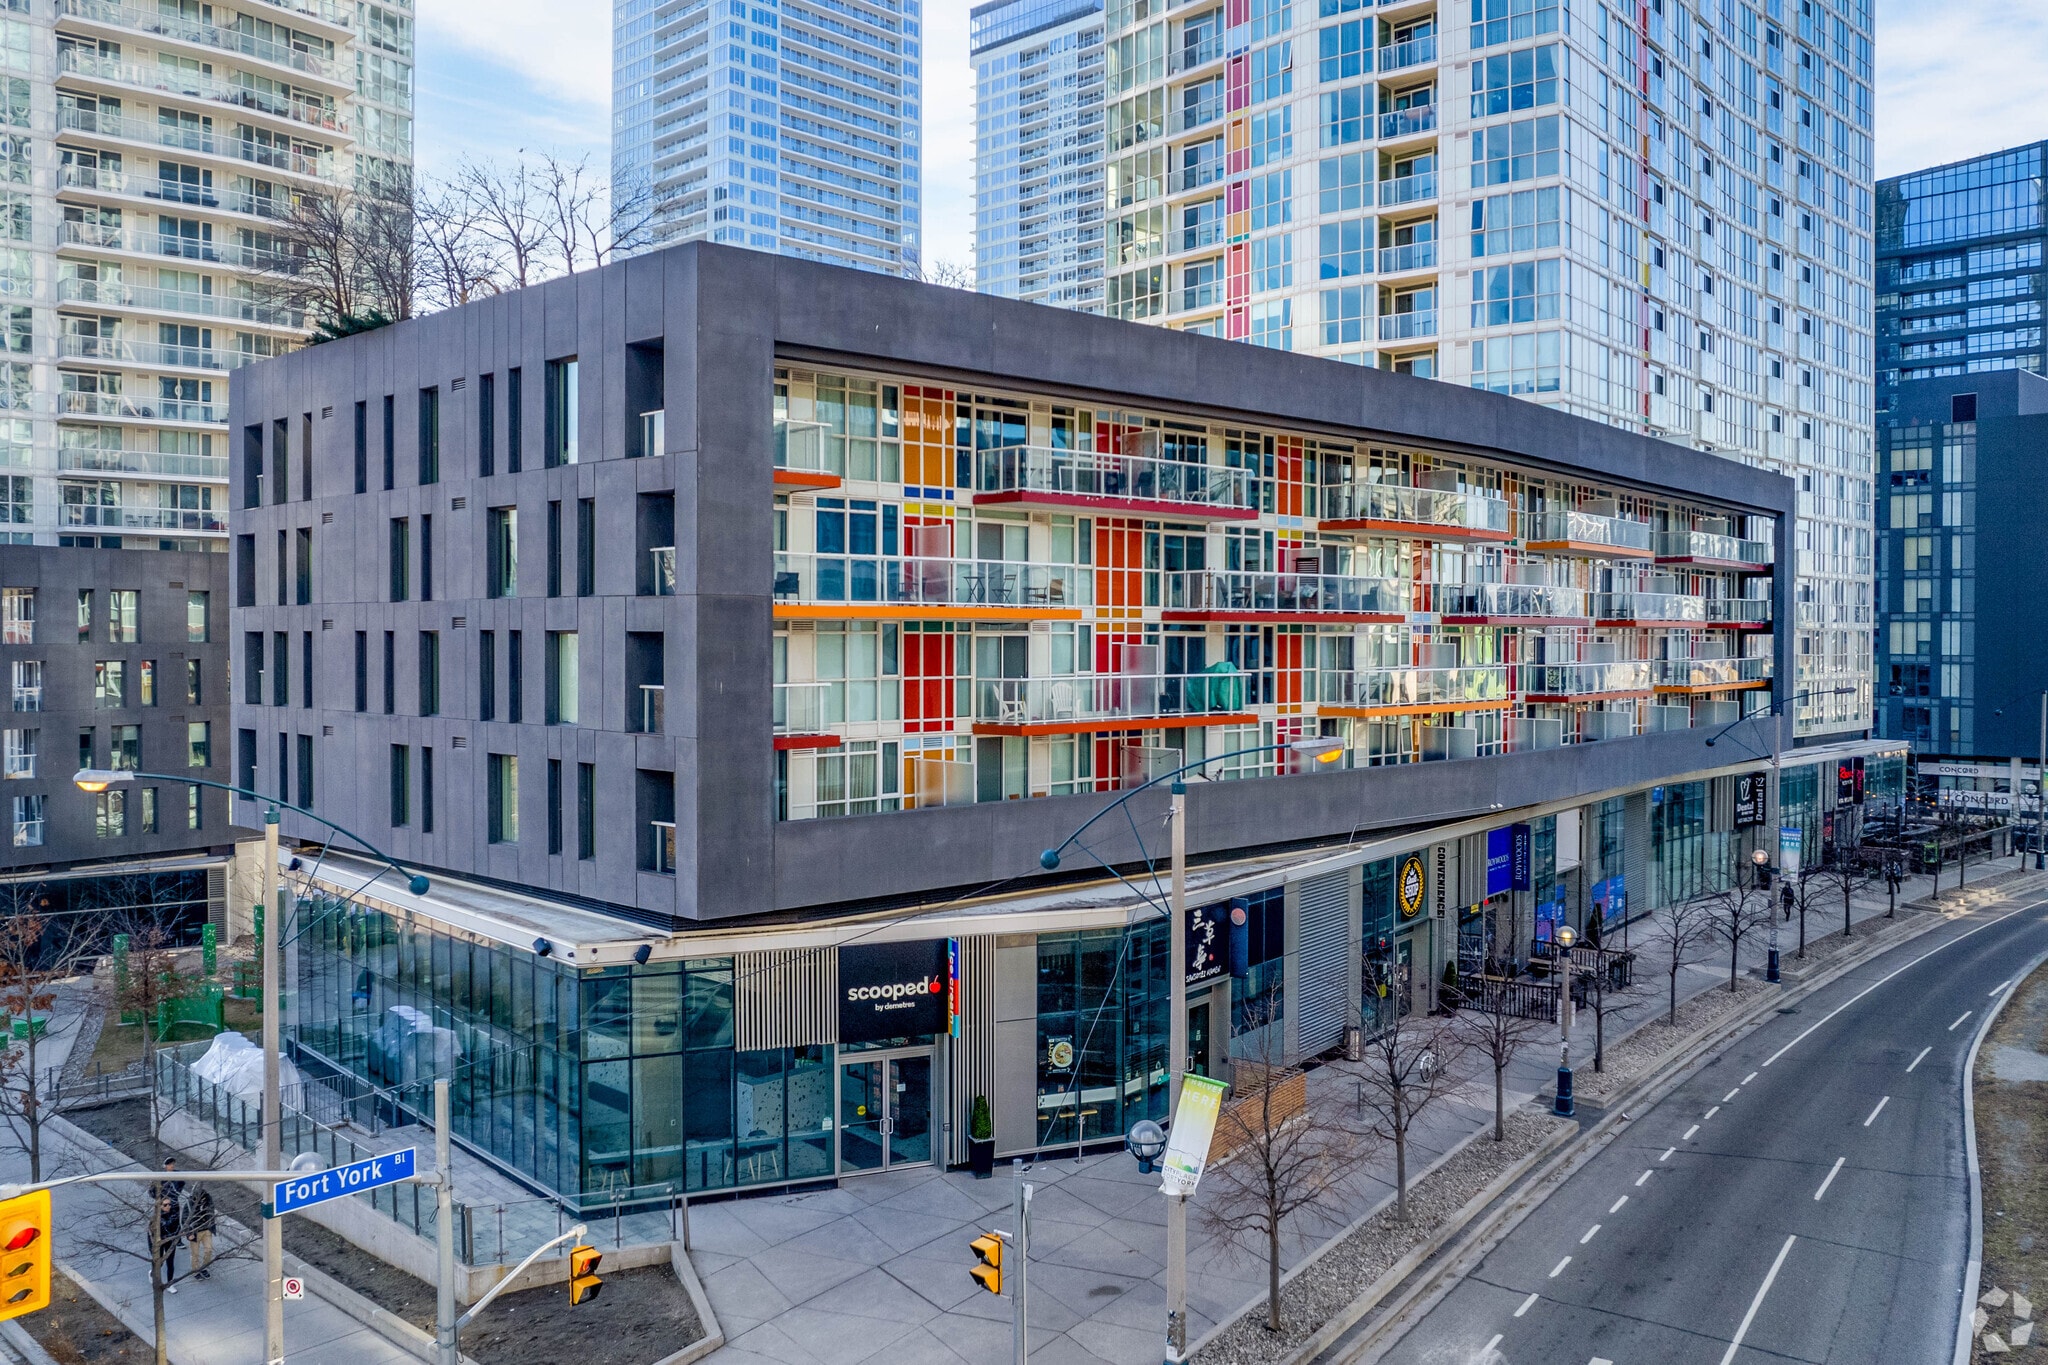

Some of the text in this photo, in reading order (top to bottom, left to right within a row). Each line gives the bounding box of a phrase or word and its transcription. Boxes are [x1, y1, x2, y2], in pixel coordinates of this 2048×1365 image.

[1939, 766, 1979, 774] CONCORD
[1756, 789, 1764, 821] Dental
[1954, 795, 2009, 805] CONCORD
[847, 976, 929, 1001] scooped
[875, 1001, 916, 1012] by demetres
[1182, 1088, 1217, 1109] HERE
[285, 1174, 330, 1204] Fort
[336, 1161, 383, 1189] York
